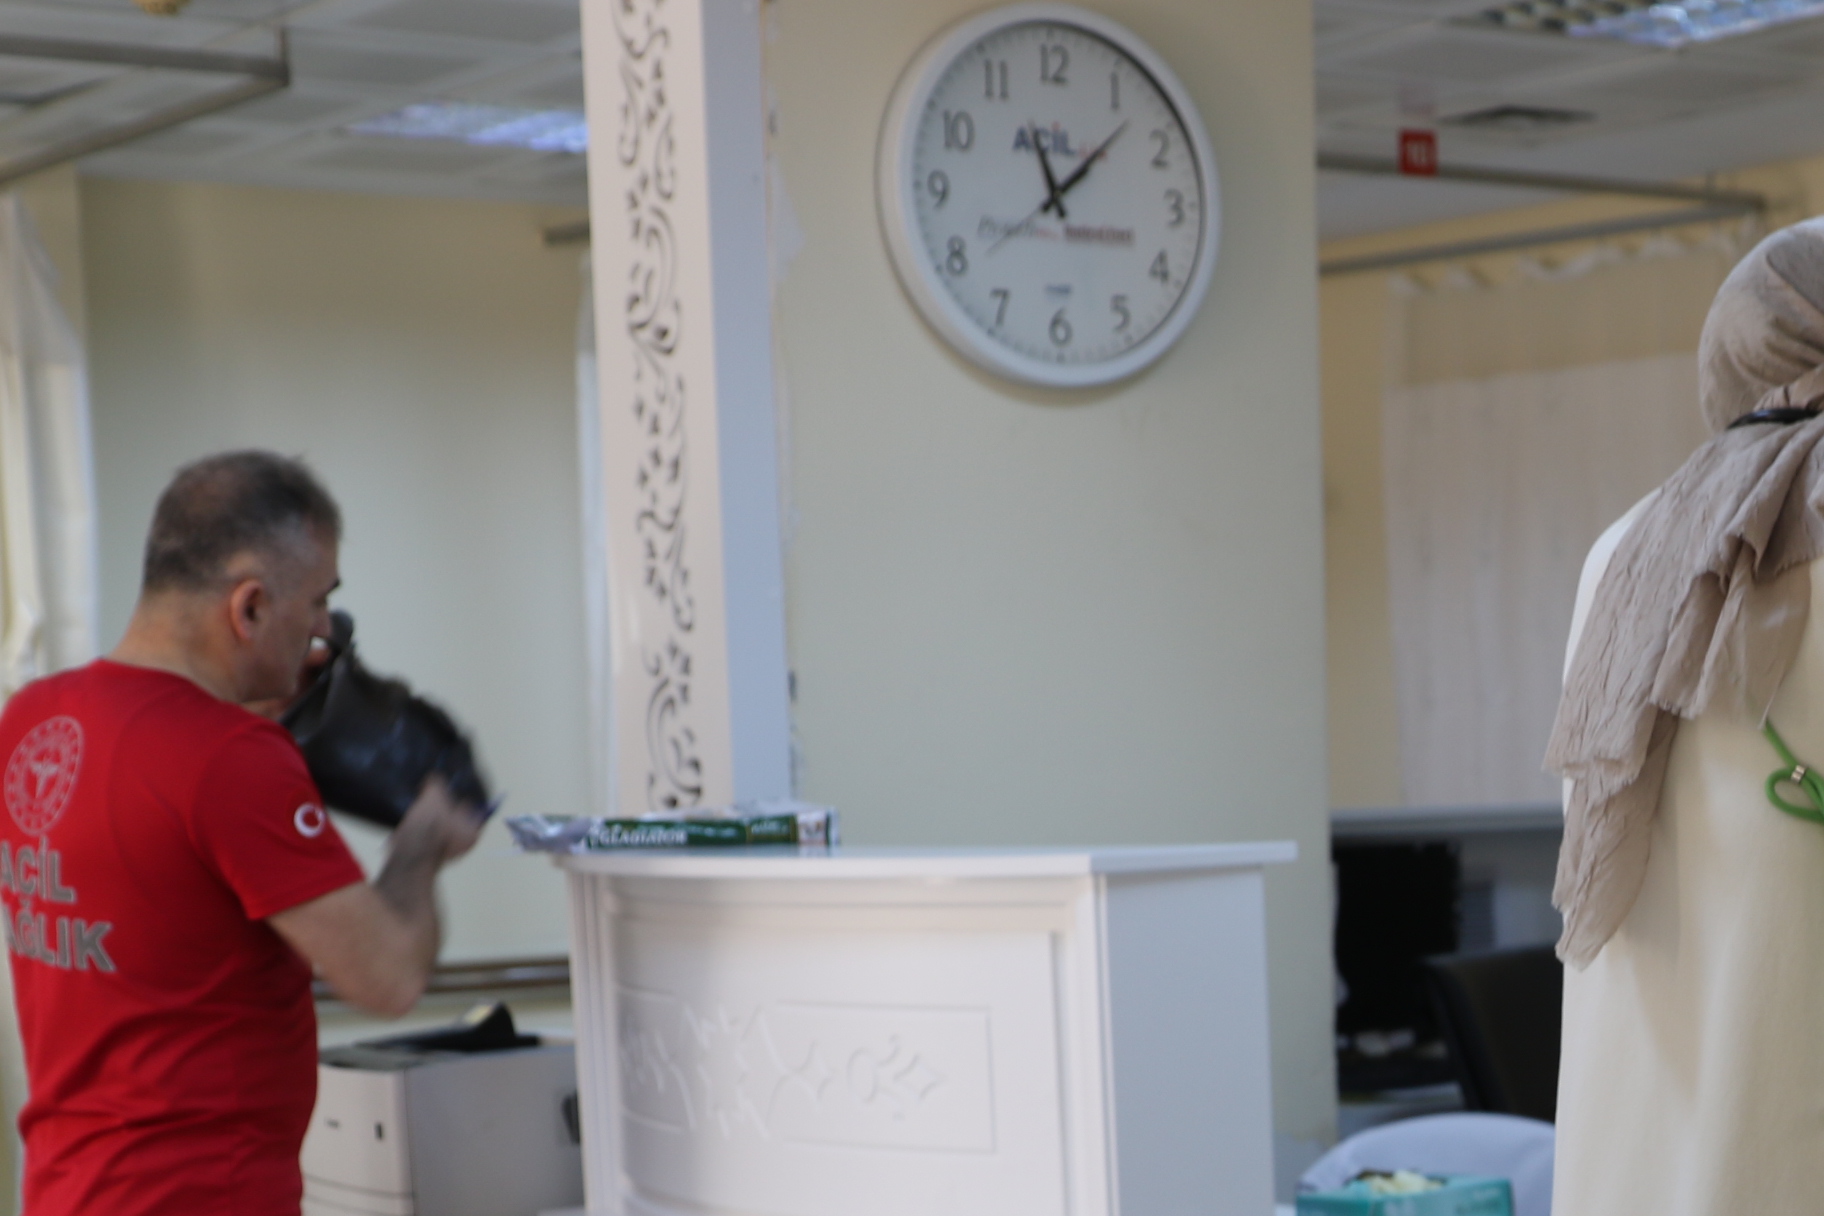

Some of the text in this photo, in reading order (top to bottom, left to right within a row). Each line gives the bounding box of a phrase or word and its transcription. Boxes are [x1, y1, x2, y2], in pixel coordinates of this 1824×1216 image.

[983, 58, 1010, 101] 11
[1040, 43, 1069, 85] 12
[1109, 72, 1121, 111] 1
[942, 110, 975, 152] 10
[1149, 128, 1171, 170] 2
[927, 169, 951, 208] 9
[1163, 190, 1185, 227] 3
[945, 235, 969, 277] 8
[1148, 248, 1170, 285] 4
[989, 287, 1011, 328] 7
[1048, 307, 1073, 346] 6
[1110, 295, 1132, 332] 5
[0, 835, 78, 906] ACİL
[2, 896, 118, 973] AĞLIK
